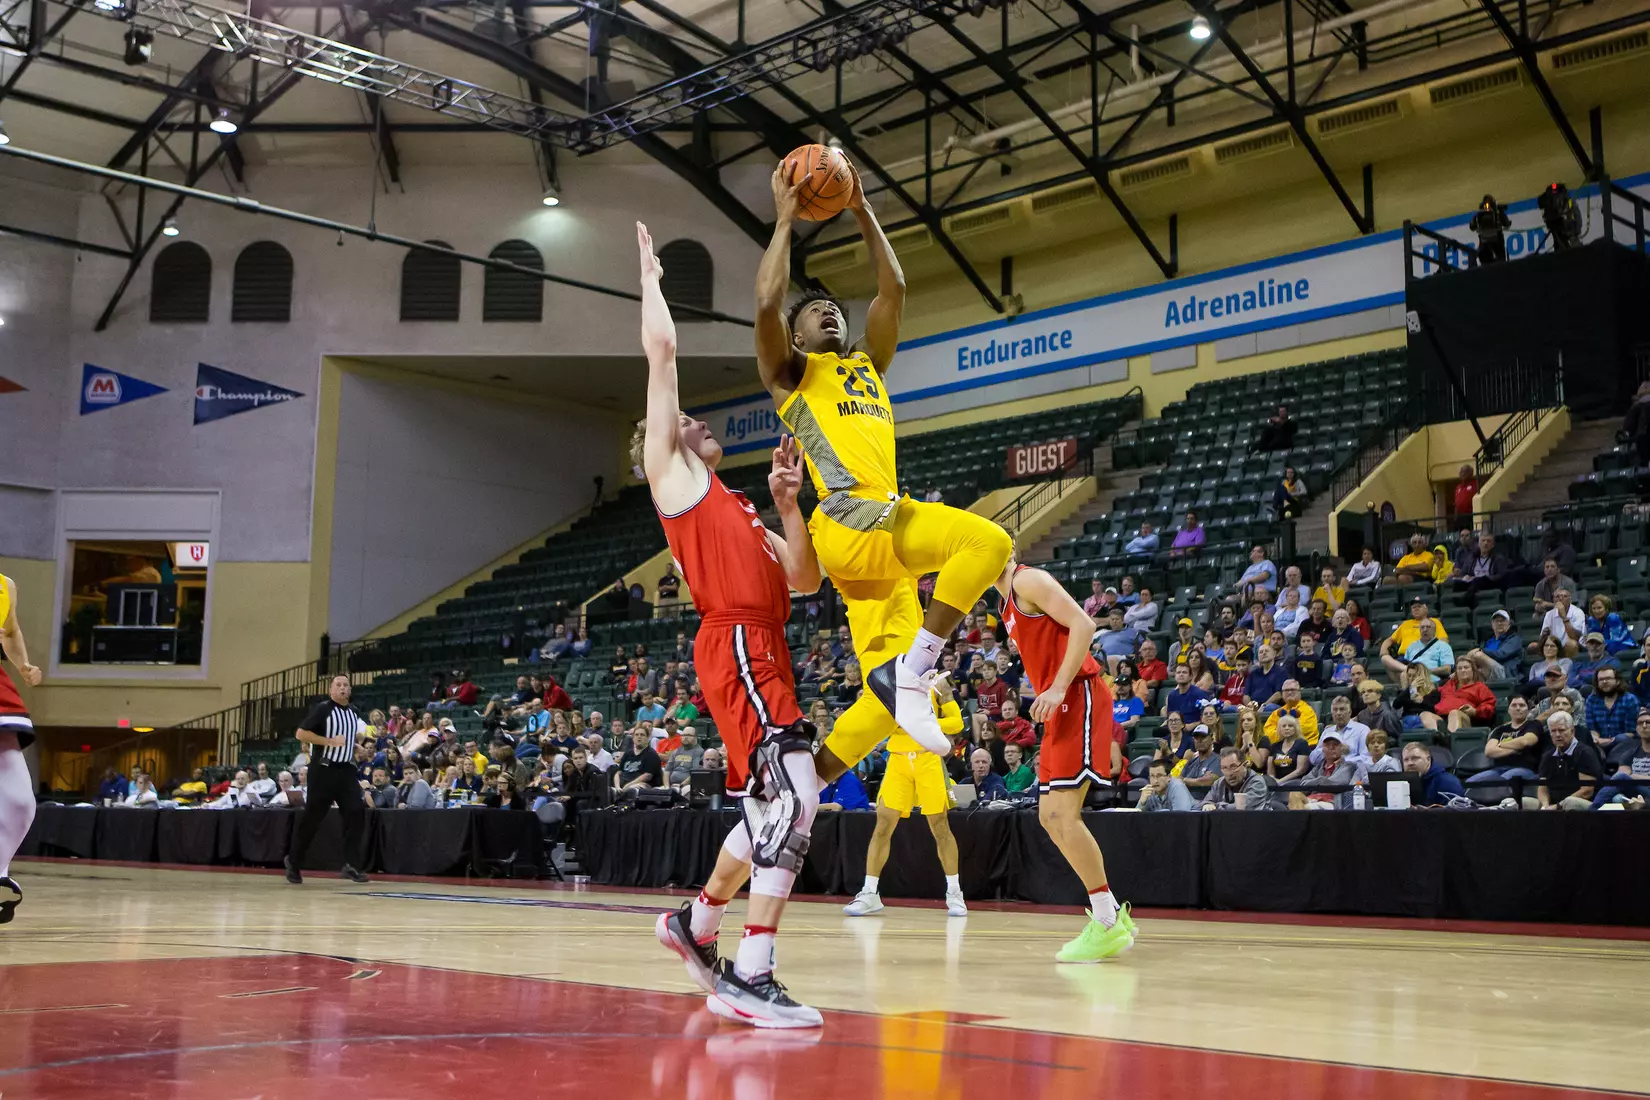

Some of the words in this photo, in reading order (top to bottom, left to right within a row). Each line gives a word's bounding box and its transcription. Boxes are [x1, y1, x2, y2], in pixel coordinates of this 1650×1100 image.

[1165, 277, 1309, 328] Adrenaline
[957, 329, 1072, 371] Endurance
[195, 385, 294, 406] Champion
[836, 365, 880, 399] 25
[725, 408, 781, 440] Agility
[1016, 442, 1068, 475] GUEST
